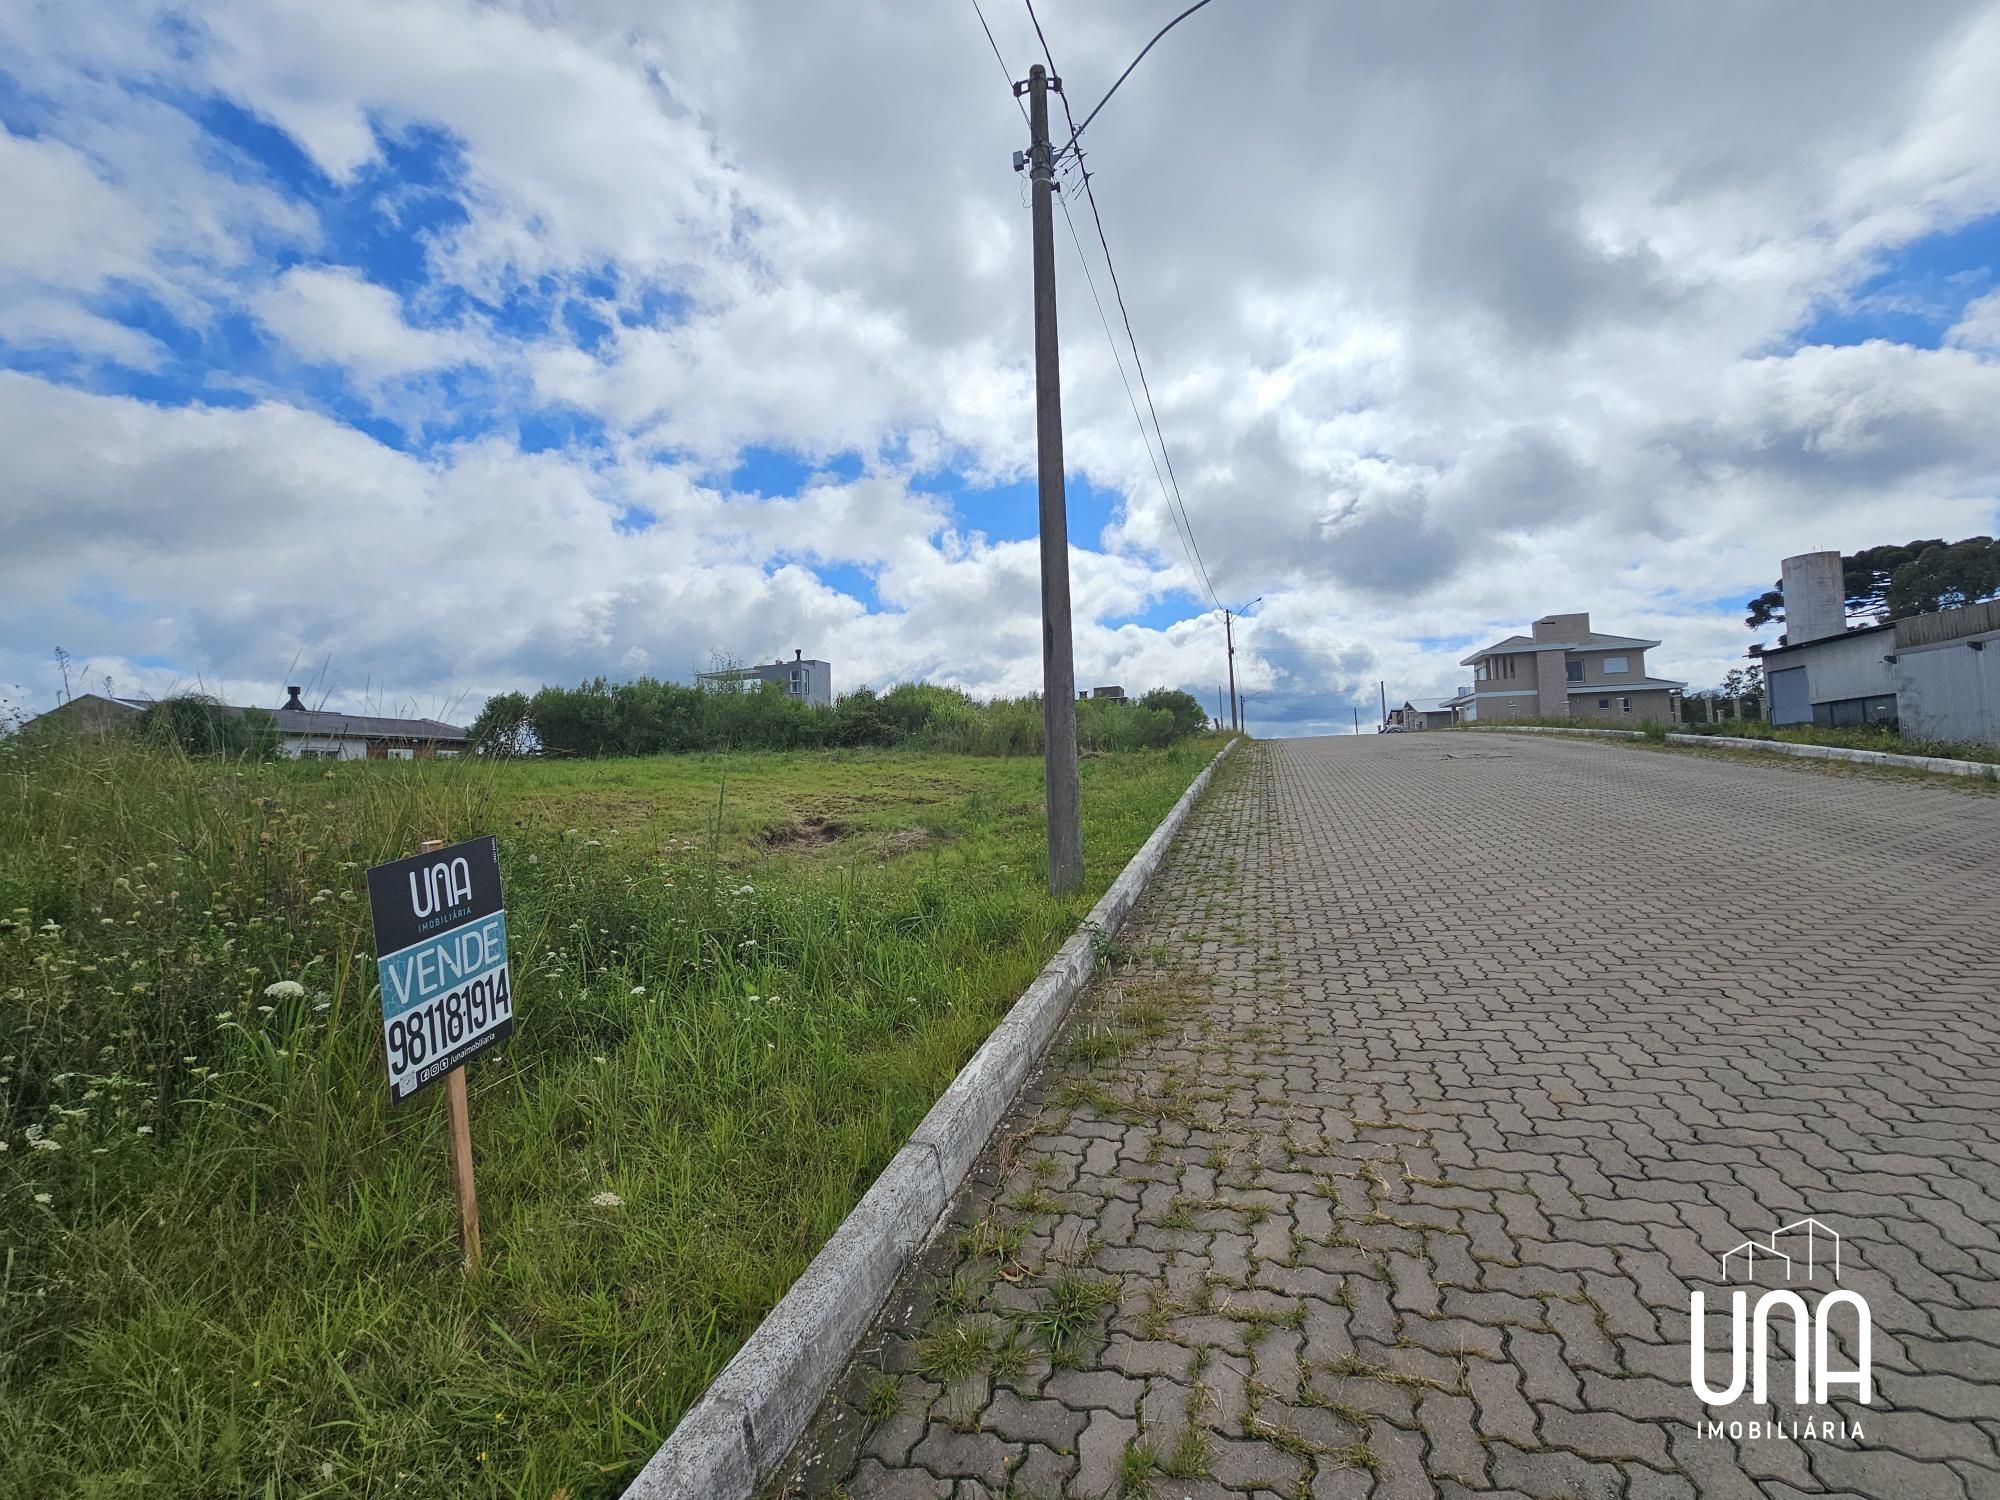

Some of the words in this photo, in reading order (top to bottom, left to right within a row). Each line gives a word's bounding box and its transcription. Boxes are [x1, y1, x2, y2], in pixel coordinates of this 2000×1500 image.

[409, 857, 472, 918] UNA
[418, 906, 472, 933] IMOBILIÁRIA
[388, 921, 500, 1005] VENDE
